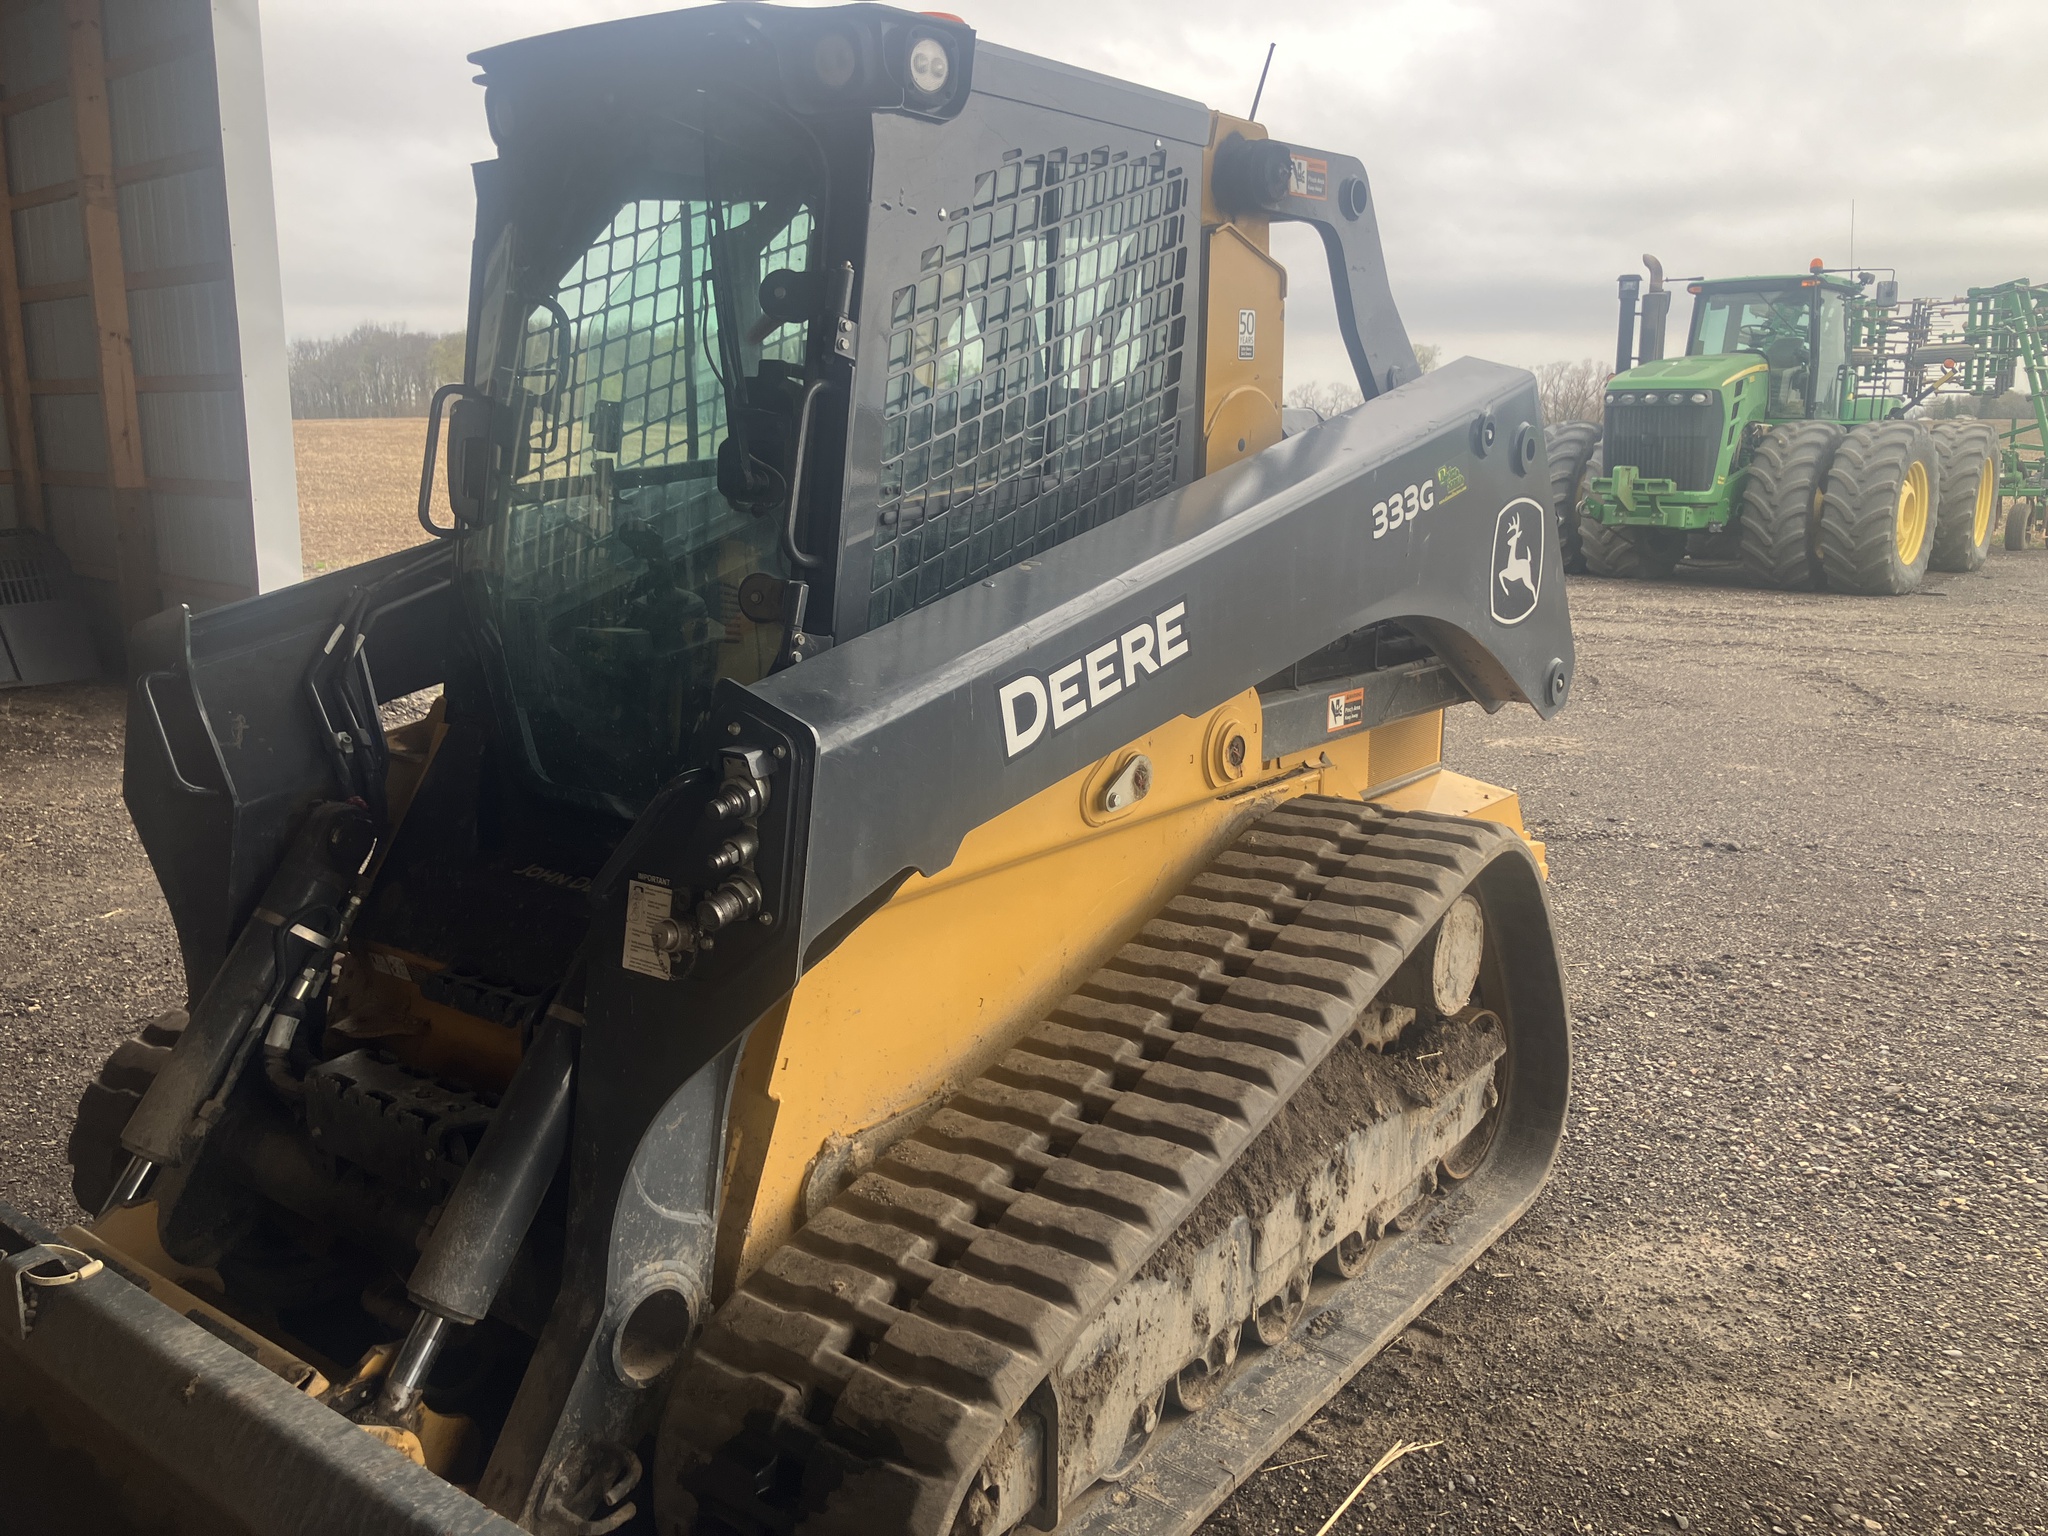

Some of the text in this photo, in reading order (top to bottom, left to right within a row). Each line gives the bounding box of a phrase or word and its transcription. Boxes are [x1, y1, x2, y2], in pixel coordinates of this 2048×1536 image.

[1240, 312, 1254, 335] 50
[1240, 336, 1254, 344] YEARS
[1372, 480, 1434, 539] 333G
[999, 601, 1189, 758] DEERE
[512, 864, 573, 885] JOHN
[638, 872, 671, 886] IMPORTANT
